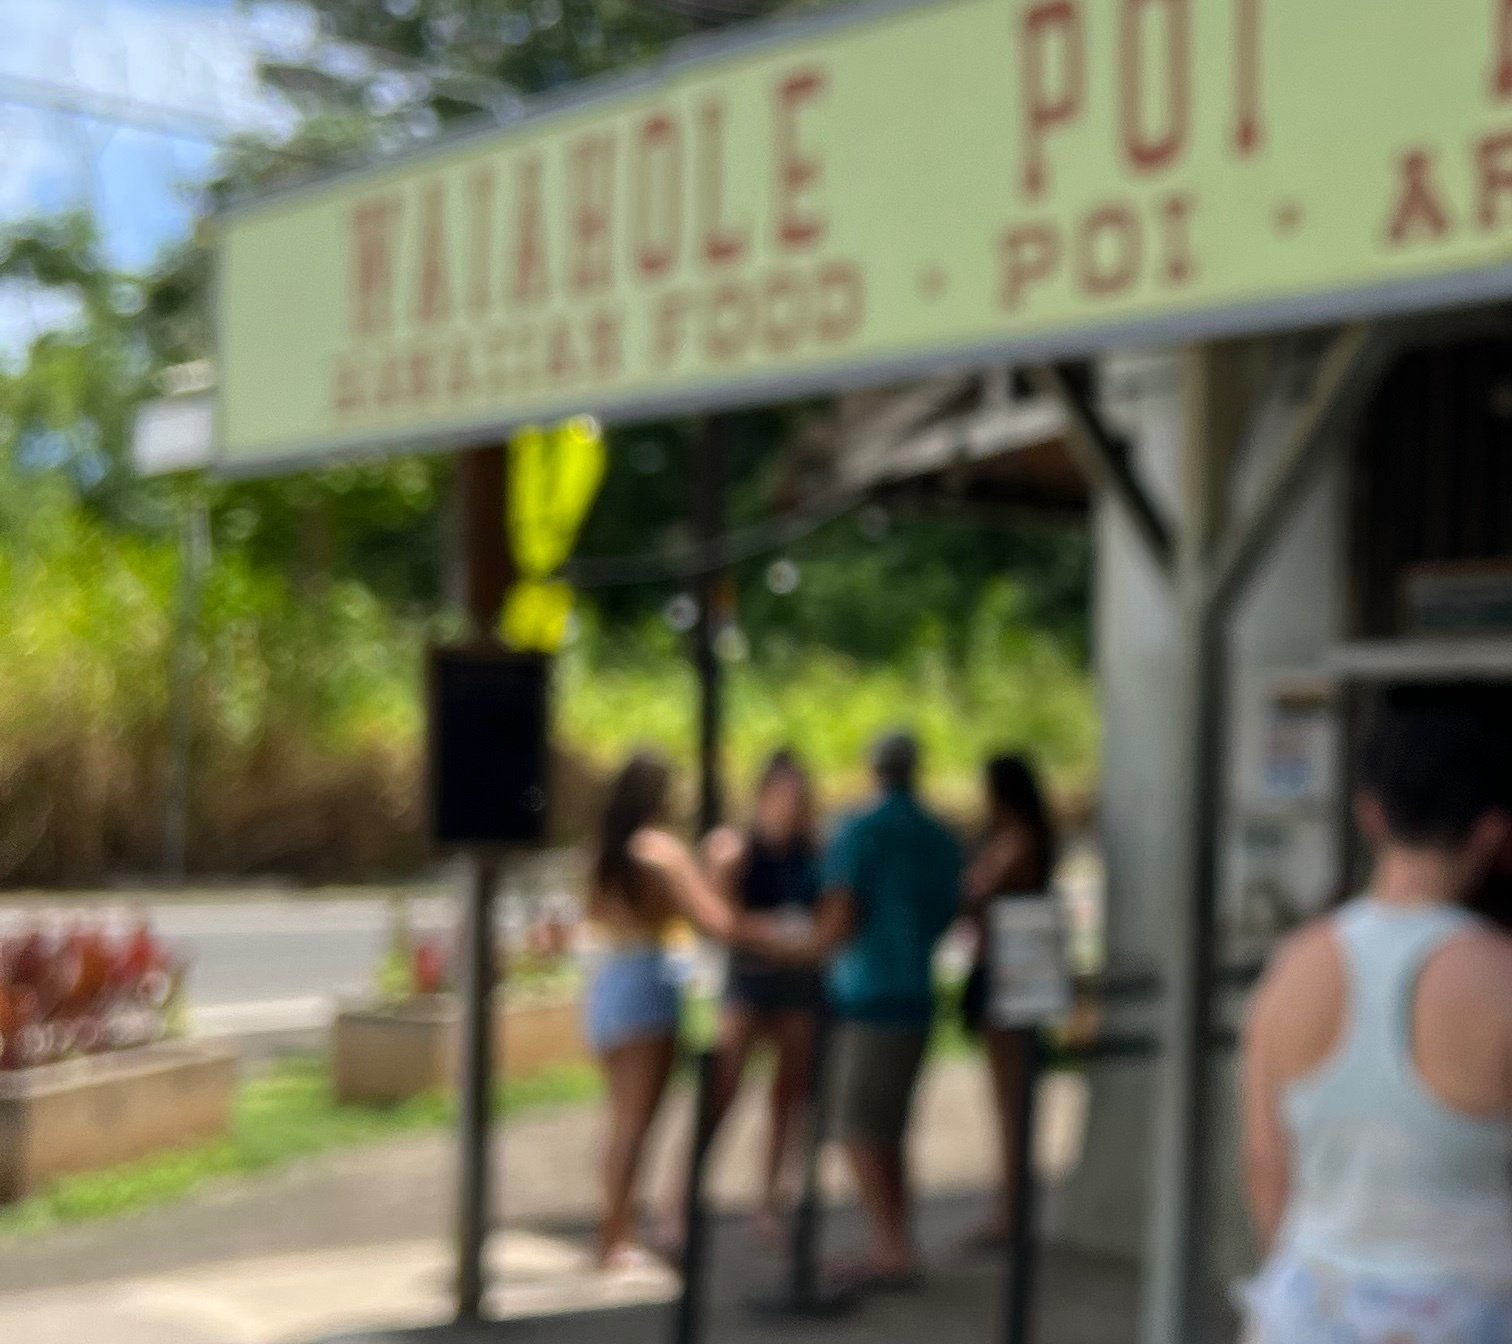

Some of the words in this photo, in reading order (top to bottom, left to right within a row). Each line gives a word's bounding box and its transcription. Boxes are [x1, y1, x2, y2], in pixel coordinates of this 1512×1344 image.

[351, 69, 823, 335] WAIAHOLE
[655, 258, 868, 369] FOOD
[1000, 193, 1200, 316] POI
